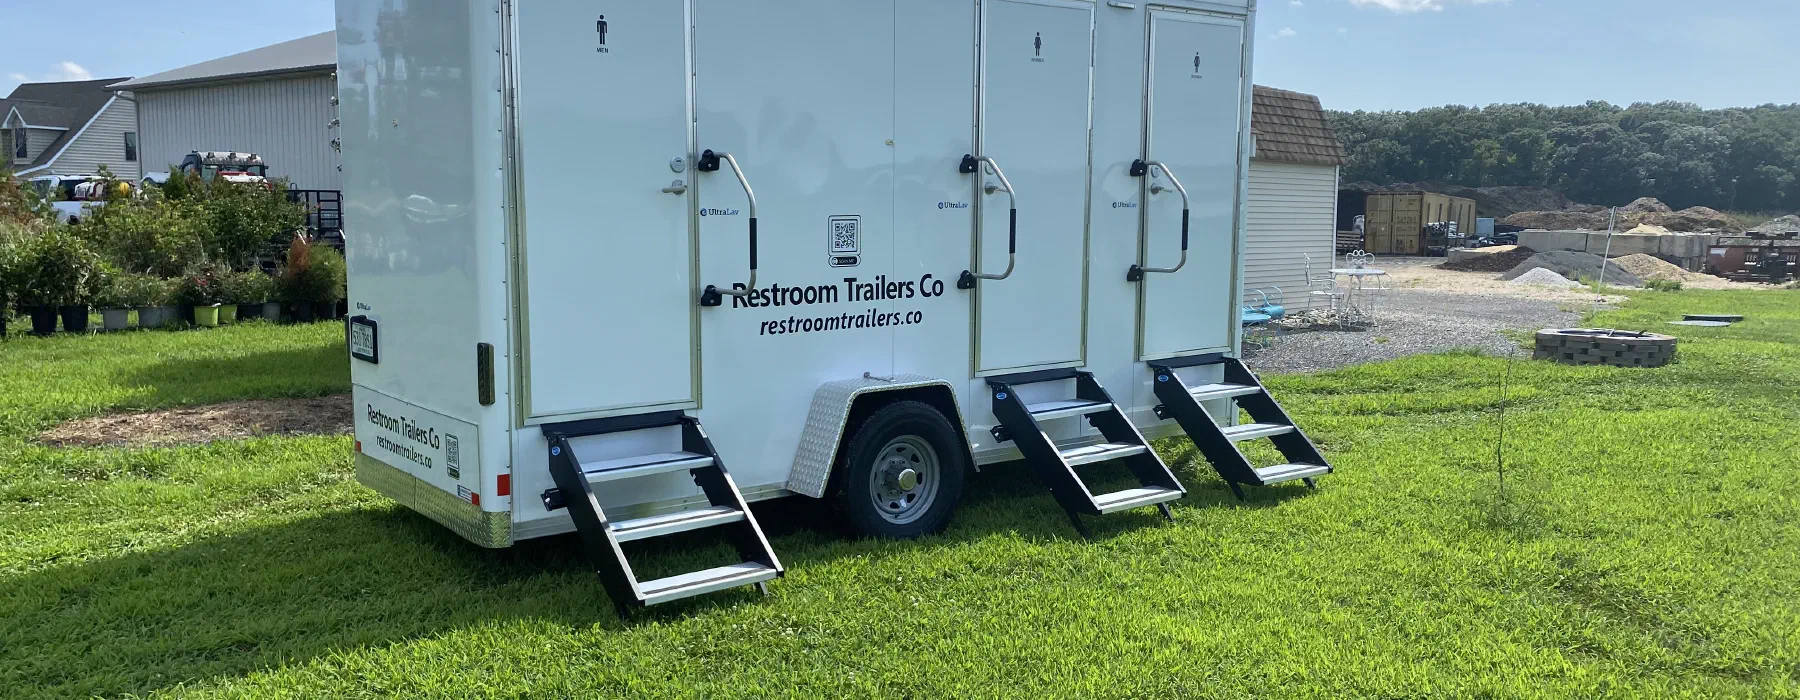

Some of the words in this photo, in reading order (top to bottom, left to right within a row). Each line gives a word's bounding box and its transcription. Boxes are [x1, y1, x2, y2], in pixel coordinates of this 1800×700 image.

[708, 208, 739, 216] UltraLav
[944, 201, 968, 209] UltraLav
[732, 282, 838, 308] Restroom
[843, 275, 915, 302] Trailers
[919, 273, 944, 298] Co
[760, 308, 923, 336] restroomtrailers.co
[367, 403, 400, 435] Restroom
[400, 416, 428, 445] Trailers
[428, 427, 440, 450] Co
[376, 435, 433, 469] restroomtrailers.co
